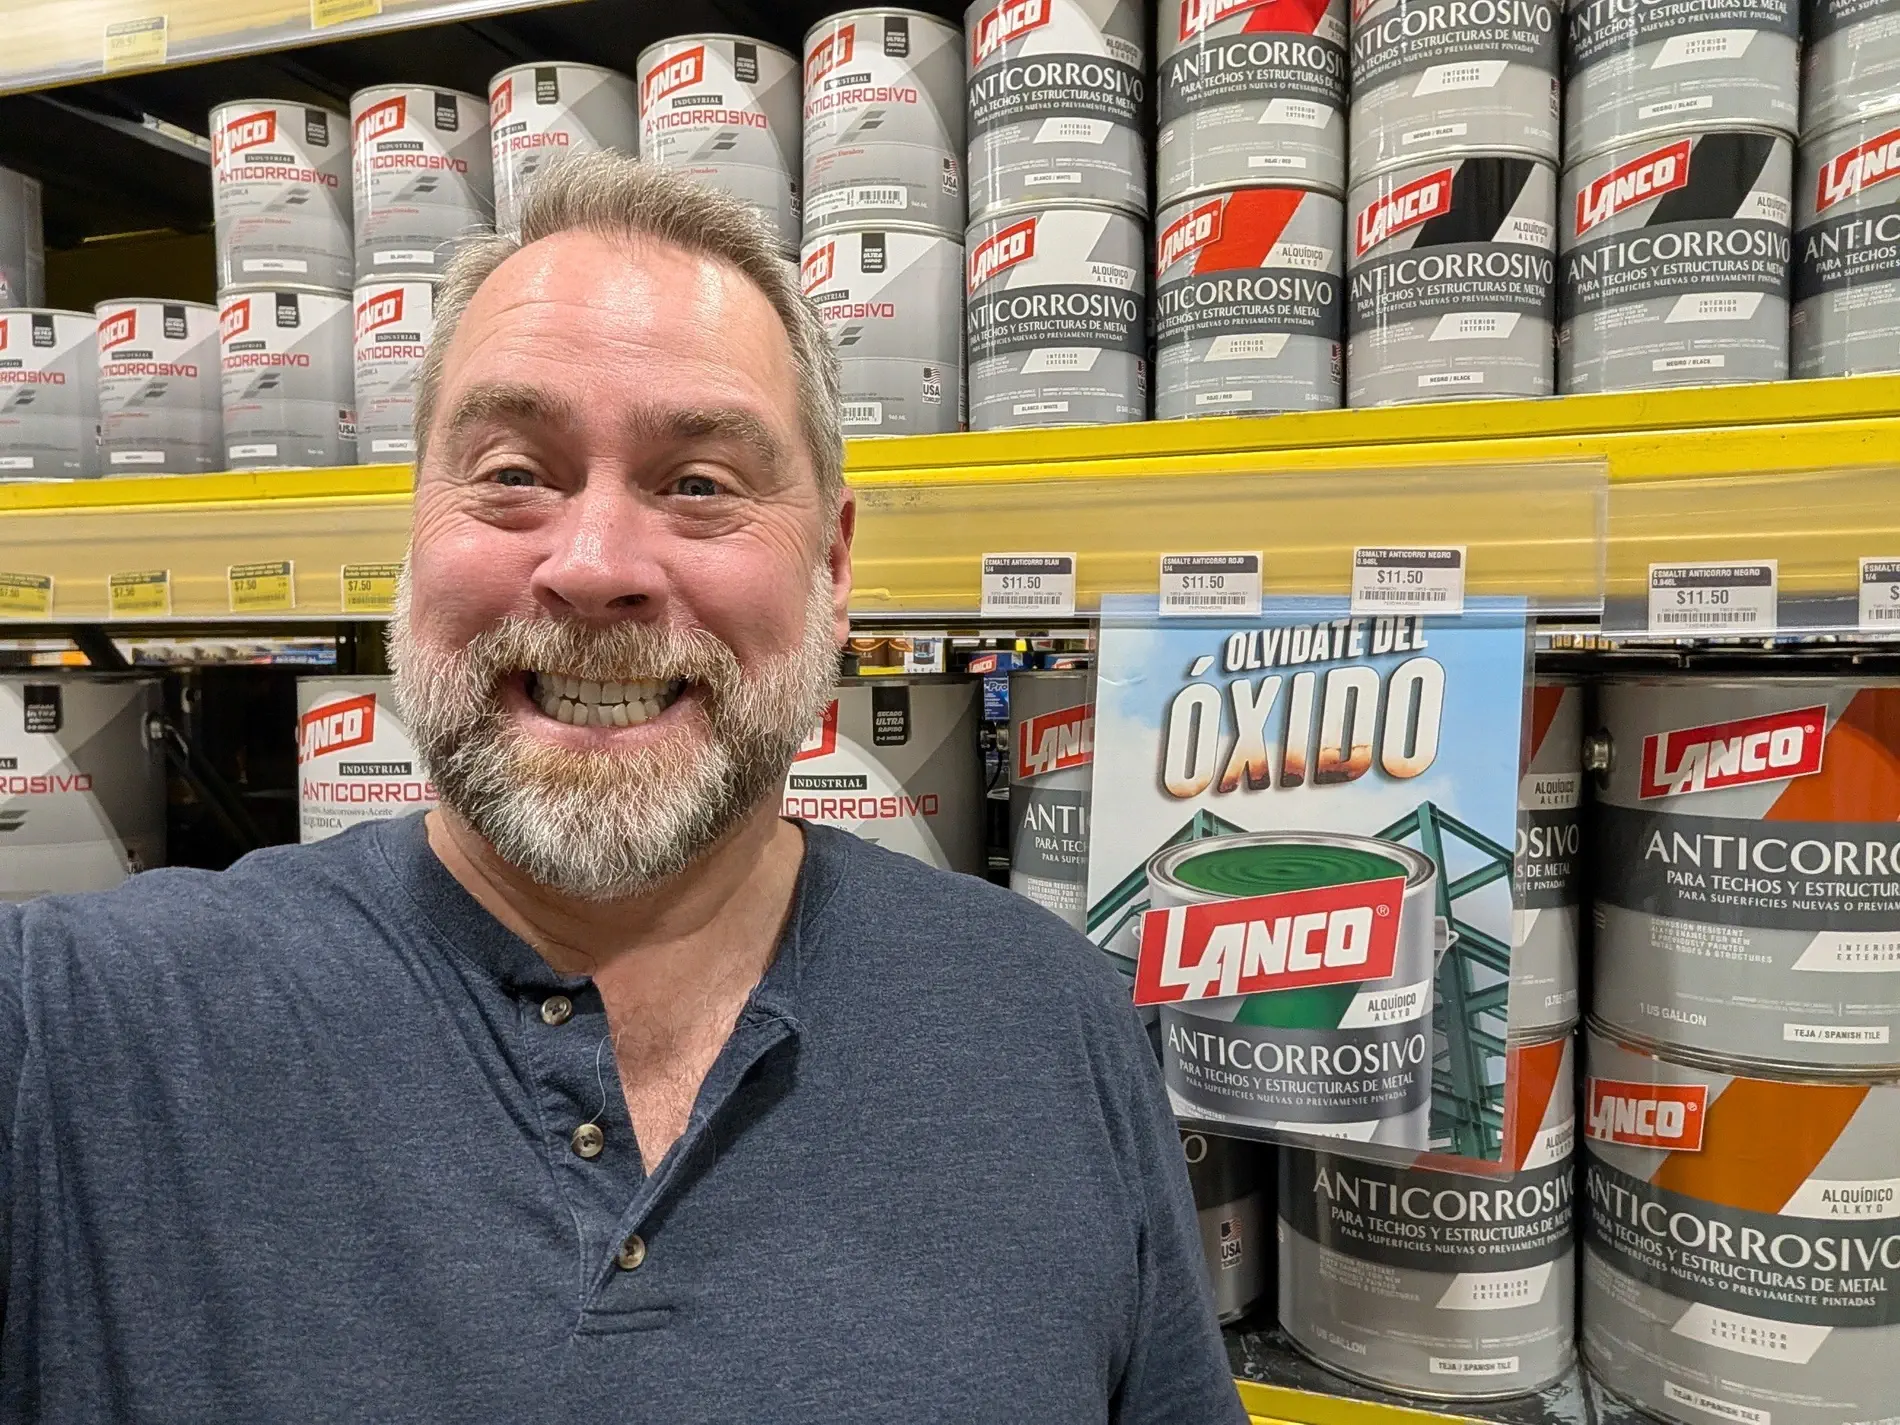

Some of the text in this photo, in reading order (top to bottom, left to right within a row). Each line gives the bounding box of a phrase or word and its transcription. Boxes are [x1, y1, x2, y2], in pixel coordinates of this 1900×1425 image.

[1594, 18, 1634, 40] TECHOS
[1640, 20, 1676, 33] NUEVAS
[1411, 28, 1540, 50] ESTRUCTURAS DE METAL
[968, 62, 1144, 112] ANTICORROSIVO
[1204, 68, 1324, 88] TECHOS ESTRUCTURAS
[1032, 89, 1100, 102] ESTRUCTURAS
[942, 175, 958, 190] USA
[1583, 156, 1677, 228] LANCO
[1362, 183, 1440, 252] LANCO
[971, 231, 1027, 288] LANCO
[1282, 246, 1323, 260] ALQUÍDICO
[1568, 230, 1790, 284] ANTICORROSIVO
[1845, 246, 1896, 265] TECHOS
[1350, 252, 1553, 300] ANTICORROSIVO
[1602, 260, 1764, 286] TECHOS Y ESTRUCTURAS DE
[1428, 281, 1521, 295] ESTRUCTURAS DE
[1602, 274, 1756, 297] SUPERFICIES NUEVAS PREVIAMENTE
[1203, 304, 1320, 319] ESTRUCTURAS DE METAL
[1018, 320, 1128, 334] ESTRUCTURAS DE METAL
[923, 384, 940, 396] USA
[1002, 576, 1041, 590] $11.50
[1182, 576, 1224, 590] $11.50
[1377, 570, 1423, 584] $11.50
[1653, 570, 1687, 578] ESMALTE
[1689, 569, 1732, 578] ANTICORRO
[1865, 573, 1876, 581] 1/4
[348, 580, 371, 591] $7.50
[1676, 590, 1729, 605] $11.50
[1225, 615, 1364, 672] OLVIDATE
[1163, 656, 1446, 799] ÓXIDO
[1026, 720, 1094, 772] LANC
[342, 764, 408, 774] INDUSTRIAL
[302, 778, 440, 802] ANTICORROS
[793, 778, 863, 788] INDUSTRIAL
[1035, 837, 1059, 850] PARA
[1545, 864, 1570, 876] METAL
[1666, 870, 1800, 895] PARA TECHOS Y
[1679, 890, 1840, 910] PARA SUPERFICIES NUEVAS
[1368, 994, 1416, 1012] ALQUÍDICO
[1374, 1008, 1411, 1021] ALKYD
[1646, 1004, 1707, 1027] US GALLON
[1795, 1029, 1815, 1038] TEJA
[1825, 1030, 1861, 1040] SPANISH
[1865, 1031, 1880, 1040] TILE
[1168, 1022, 1425, 1076] ANTICORROSIVO
[1179, 1059, 1413, 1094] PARA TECHOS Y ESTRUCTURAS DE METAL
[1186, 1076, 1407, 1106] PARA SUPERFICIES NUEVAS O PREVIAMENTE PINTADAS
[1822, 1186, 1893, 1204] ALQUÍDICO
[1831, 1204, 1883, 1214] ALKYD
[1332, 1206, 1553, 1242] PARA TECHOS Y ESTRUCTURAS DE
[1341, 1225, 1545, 1254] PARA SUPERFICIES NUEVAS PREVIAMENTE
[1222, 1241, 1241, 1260] USA
[1615, 1222, 1888, 1293] TECHOS ESTRUCTURAS DE METAL
[1473, 1280, 1528, 1291] INTERIOR
[1671, 1266, 1876, 1307] NUEVAS PREVIAMENTE PINTADAS
[1464, 1362, 1511, 1370] SPANISH TILE
